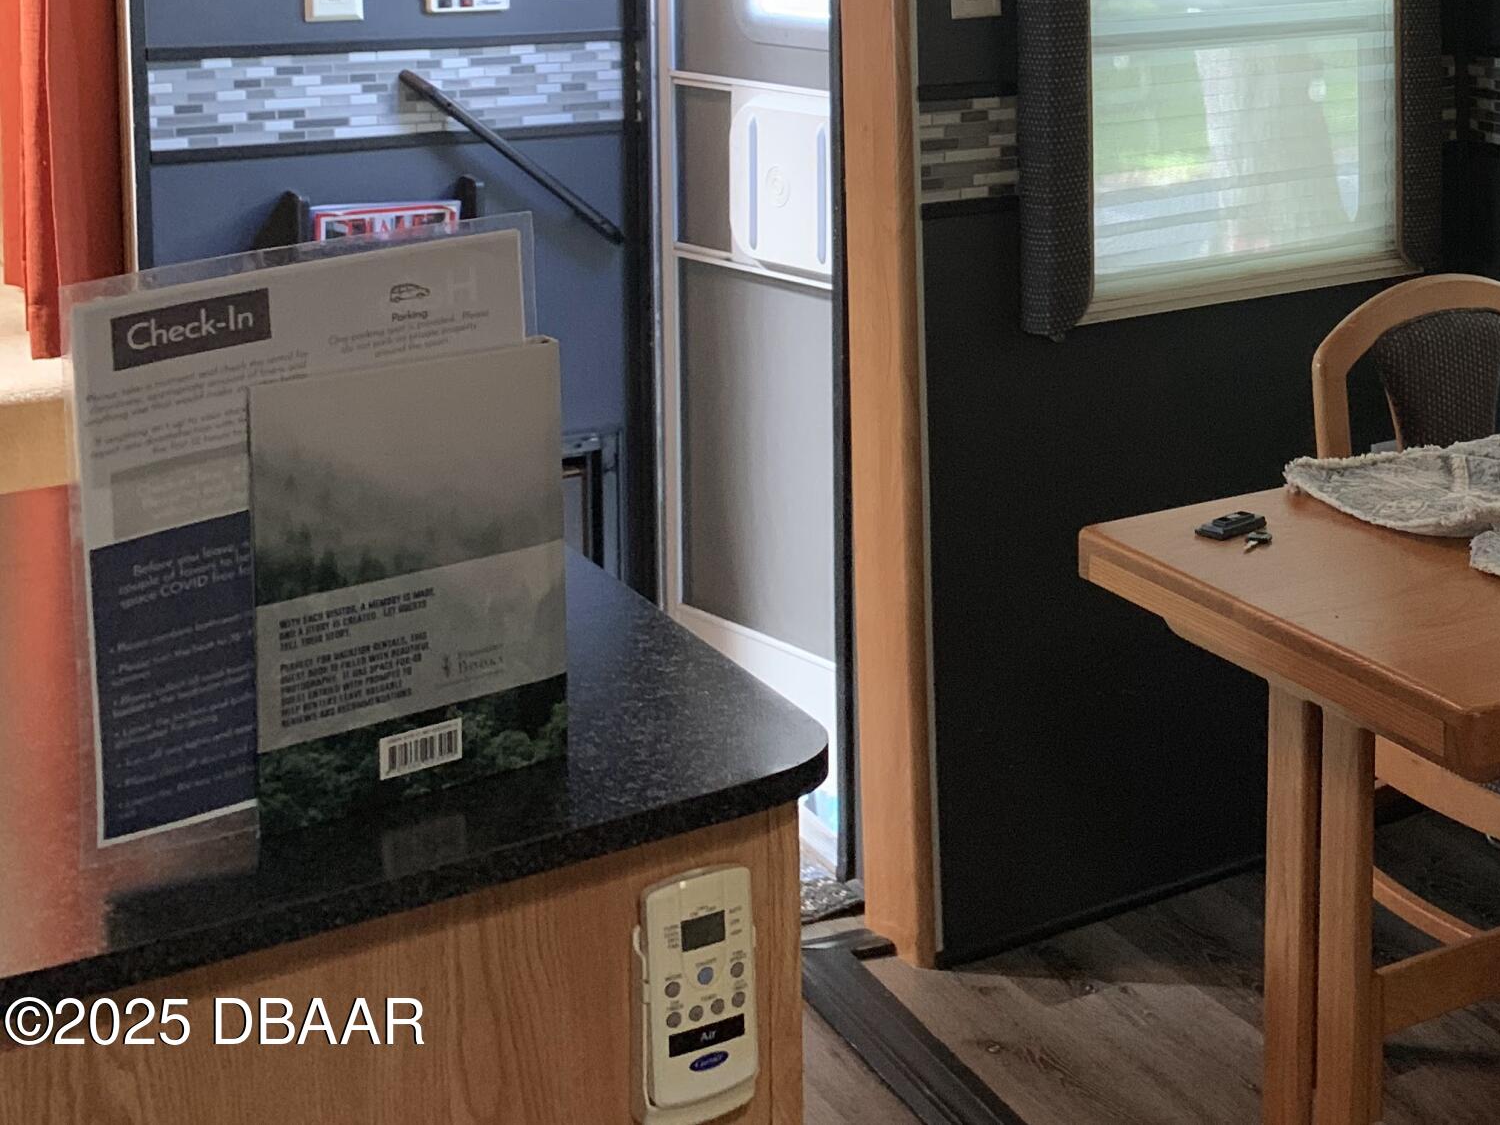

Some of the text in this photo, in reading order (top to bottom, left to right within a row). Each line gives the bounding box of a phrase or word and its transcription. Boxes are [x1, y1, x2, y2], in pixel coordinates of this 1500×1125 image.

[392, 310, 428, 322] Parking
[127, 305, 254, 350] Check-In
[160, 575, 208, 597] COVID
[368, 595, 400, 609] MEMORY
[403, 592, 411, 602] IS
[305, 621, 329, 635] STORY
